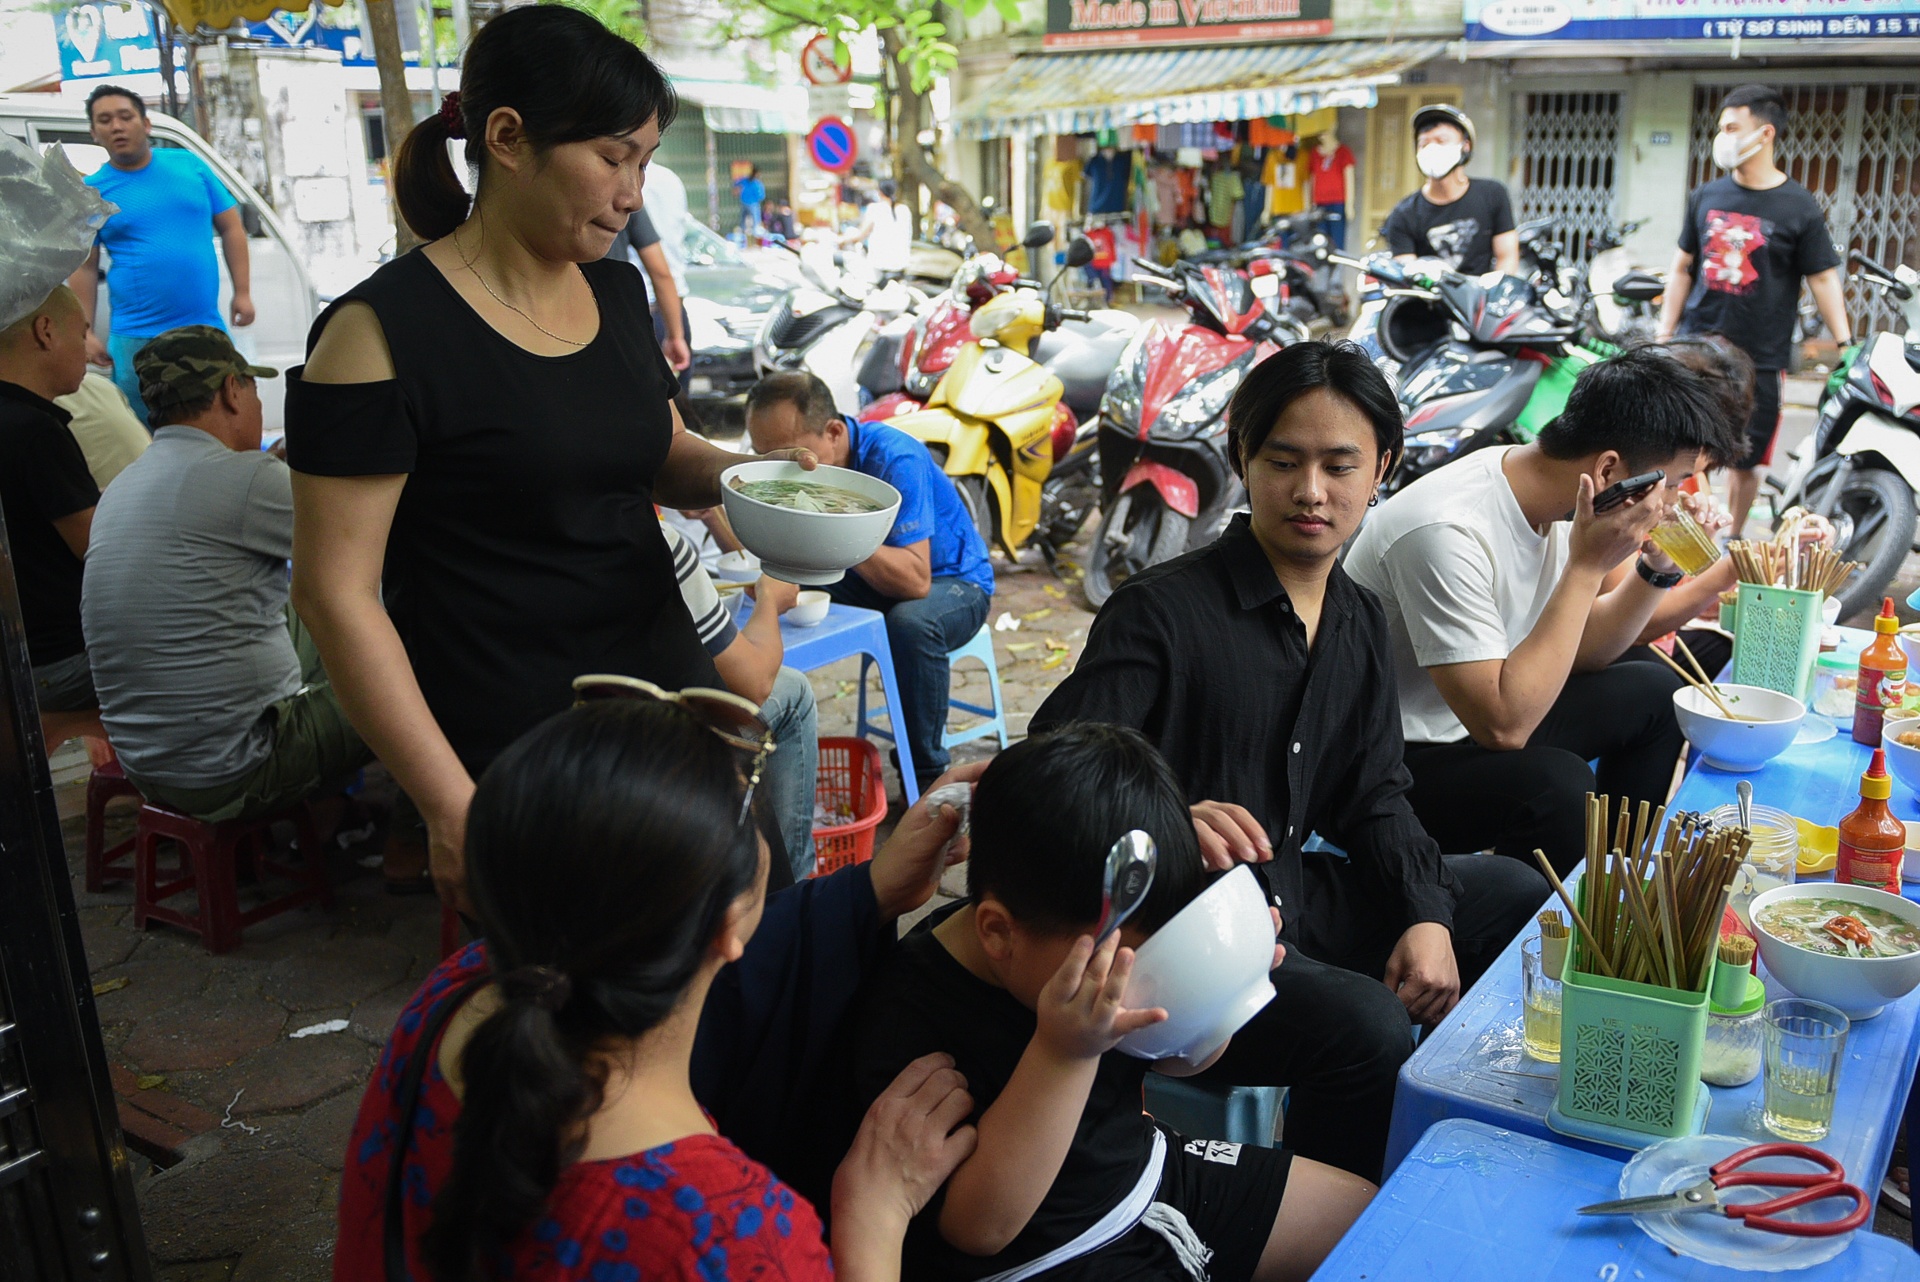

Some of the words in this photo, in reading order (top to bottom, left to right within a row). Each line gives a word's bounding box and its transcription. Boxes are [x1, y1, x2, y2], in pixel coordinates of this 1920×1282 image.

[1069, 0, 1147, 30] Made
[1148, 0, 1179, 26] in
[1776, 19, 1823, 36] SINH
[1827, 15, 1871, 35] ĐẾN
[1875, 19, 1903, 34] 15
